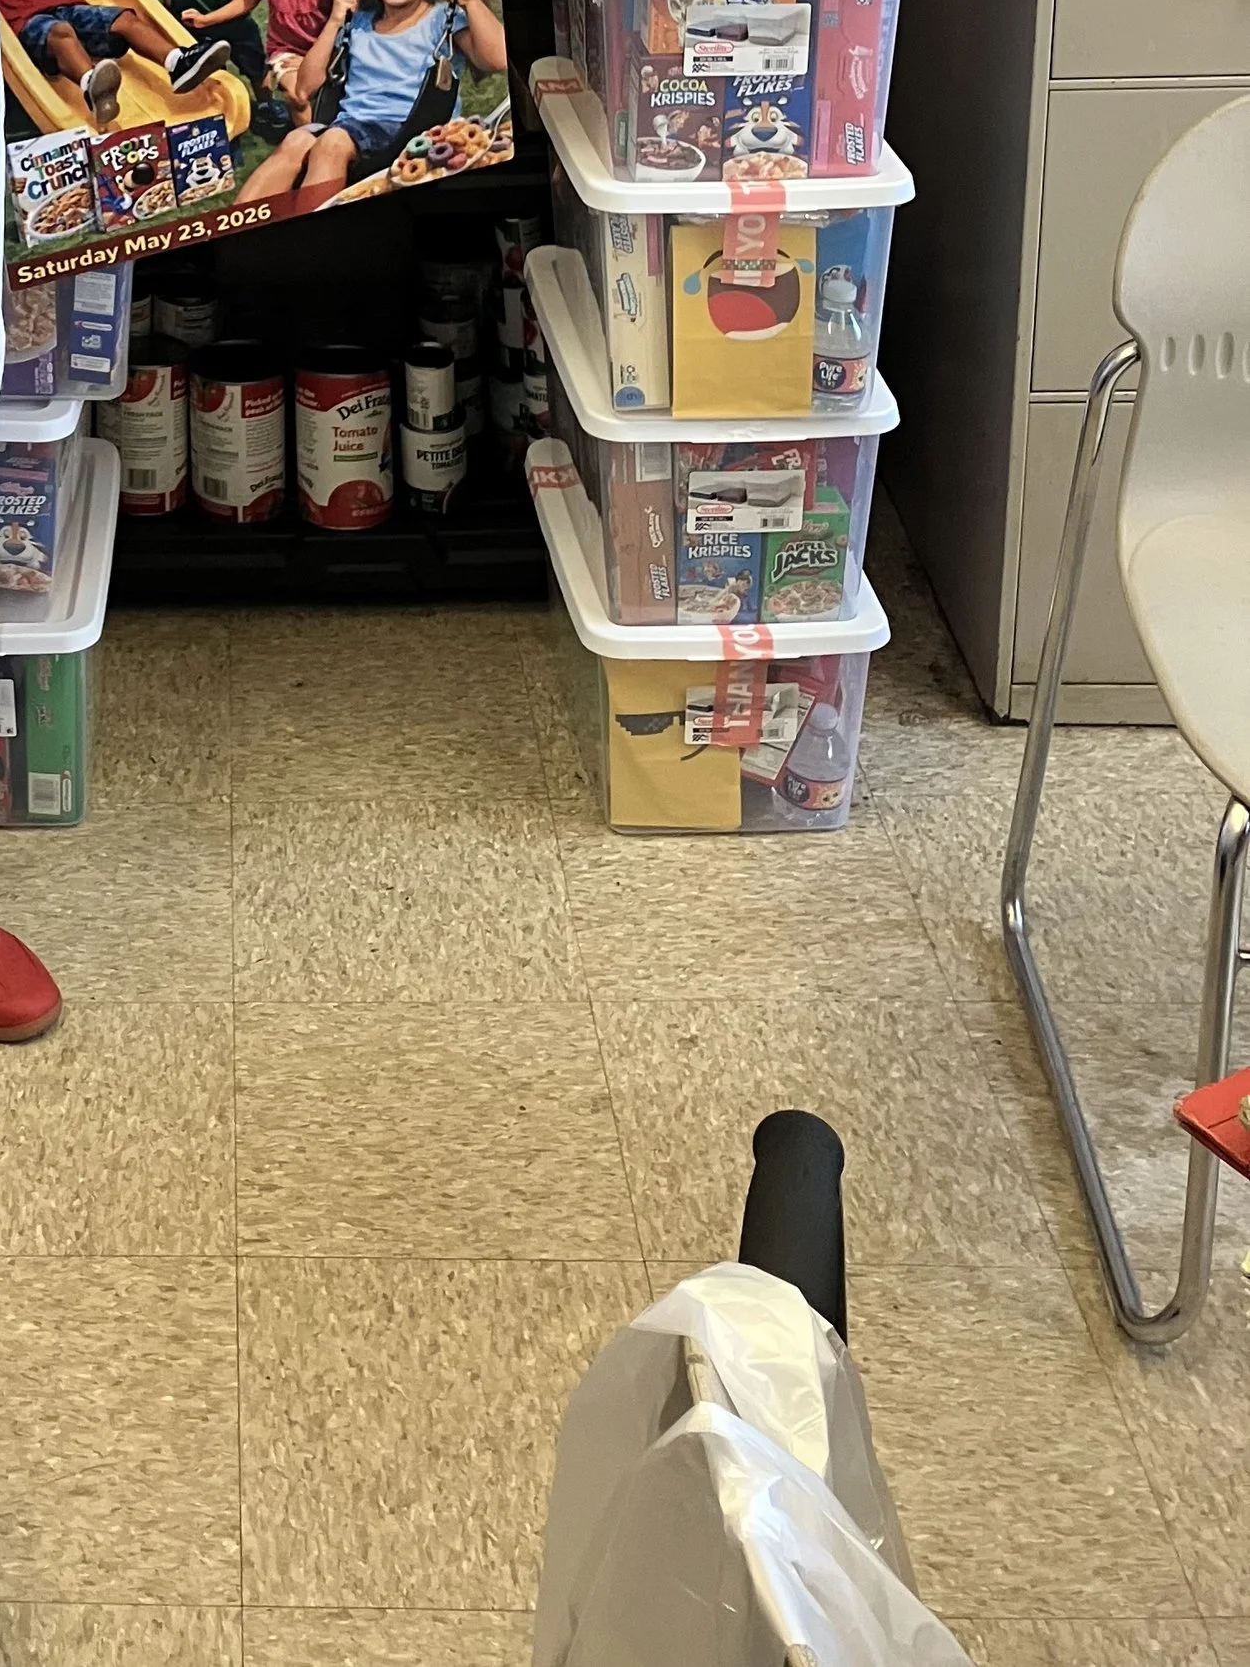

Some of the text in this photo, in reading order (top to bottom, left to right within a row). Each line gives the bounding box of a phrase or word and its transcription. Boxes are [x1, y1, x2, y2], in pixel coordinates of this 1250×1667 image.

[659, 78, 708, 92] COCOA
[736, 78, 792, 97] FLAKES
[650, 91, 716, 108] KRISPIES
[844, 122, 856, 165] FROSTED
[855, 126, 866, 163] FLAKES
[20, 136, 92, 172] Cinnamon
[37, 152, 83, 181] Toast
[27, 163, 91, 201] Crunch
[17, 203, 272, 283] Saturday May 23, 2026
[331, 425, 379, 438] Tomato
[332, 440, 365, 452] Juice
[703, 534, 739, 546] RICE
[785, 539, 826, 552] APPLE
[688, 545, 752, 559] KRISPIES
[772, 549, 838, 582] JACKS
